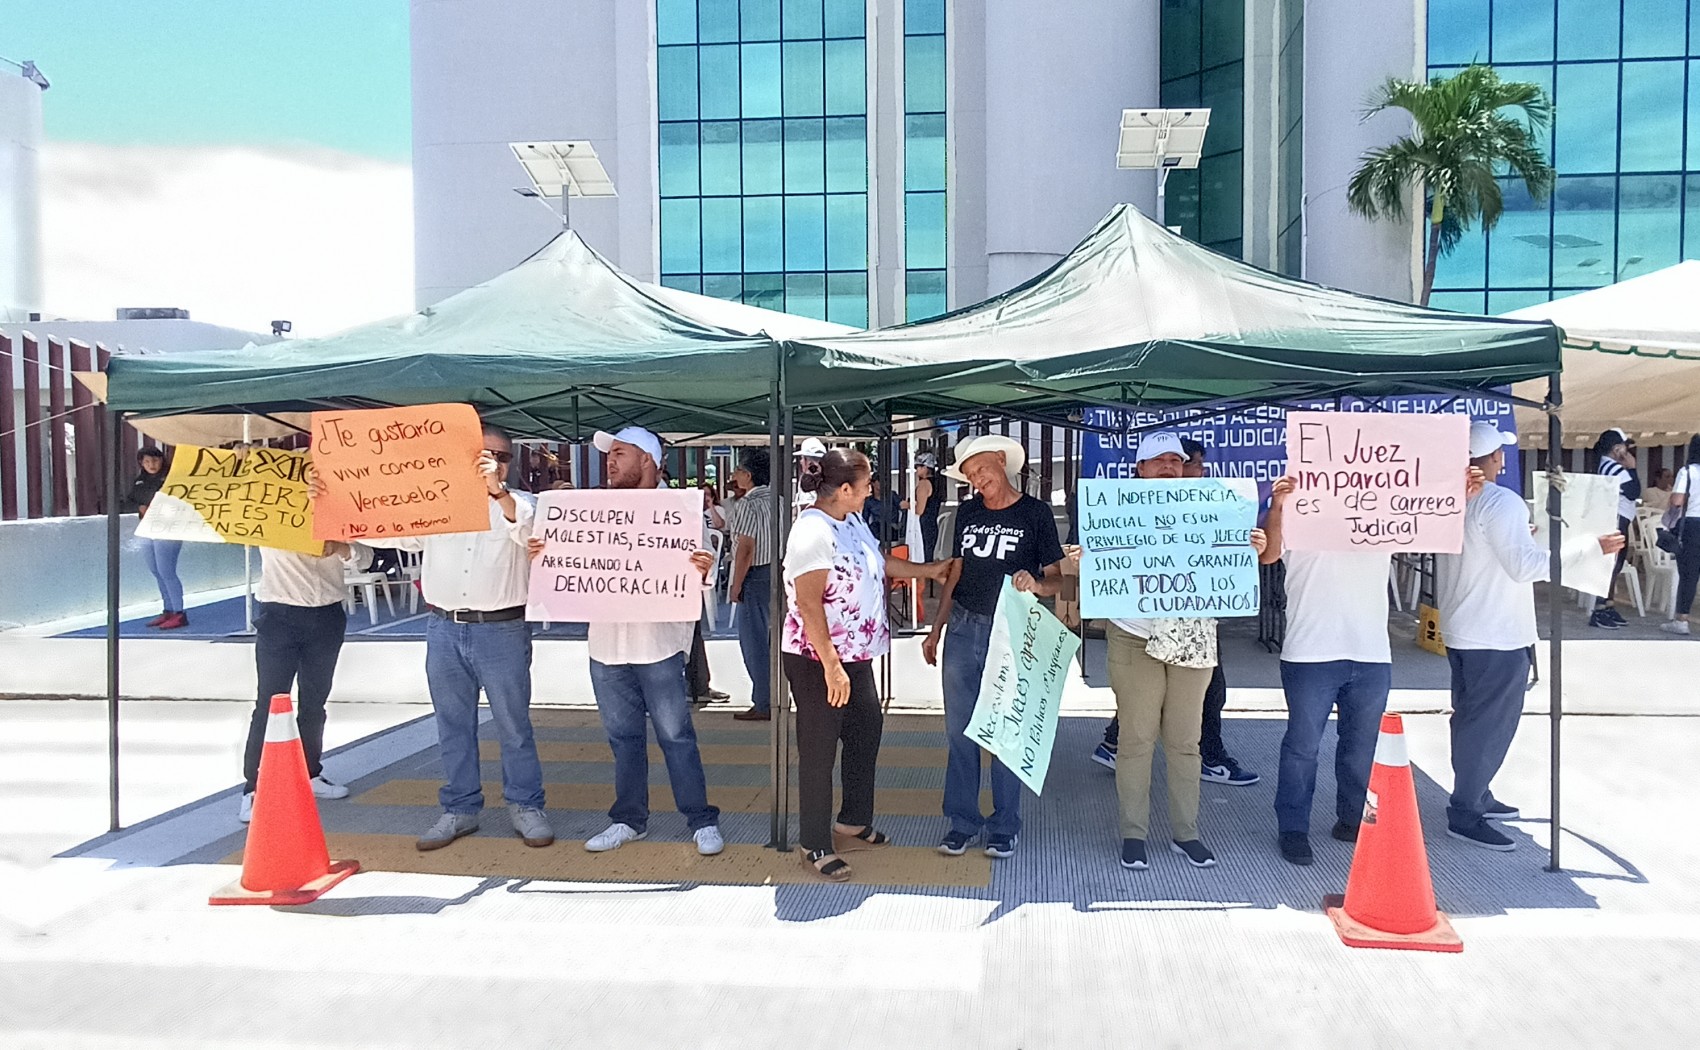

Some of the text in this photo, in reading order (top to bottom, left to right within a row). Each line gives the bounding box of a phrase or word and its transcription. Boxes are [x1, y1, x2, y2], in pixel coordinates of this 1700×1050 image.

[318, 418, 446, 455] ¿Te gustaría
[1098, 432, 1122, 449] EN
[1218, 427, 1288, 448] JUDICIA
[1299, 422, 1332, 464] El
[379, 460, 424, 476] como
[428, 457, 447, 468] en
[349, 479, 450, 513] Venezuela?
[1086, 486, 1108, 507] LA
[1295, 498, 1321, 515] es
[1344, 491, 1378, 511] de
[243, 504, 268, 520] ES
[277, 511, 304, 527] TU
[546, 506, 682, 525] DISCULPEN LAS
[1082, 513, 1219, 532] JUDICIAL NO ES UN
[392, 522, 404, 533] la
[544, 528, 697, 551] MOLESTIAS, ESTAMOS
[960, 534, 1020, 560] PJF
[1086, 534, 1157, 550] PRIVILEGIO
[1162, 533, 1179, 544] DE
[1184, 532, 1206, 544] LOS
[541, 554, 643, 572] ARREGLANDO LA
[1095, 553, 1254, 571] SINO UNA GARANTÍA
[1091, 571, 1236, 597] PARA TODOS LOS
[1020, 746, 1036, 777] NO
